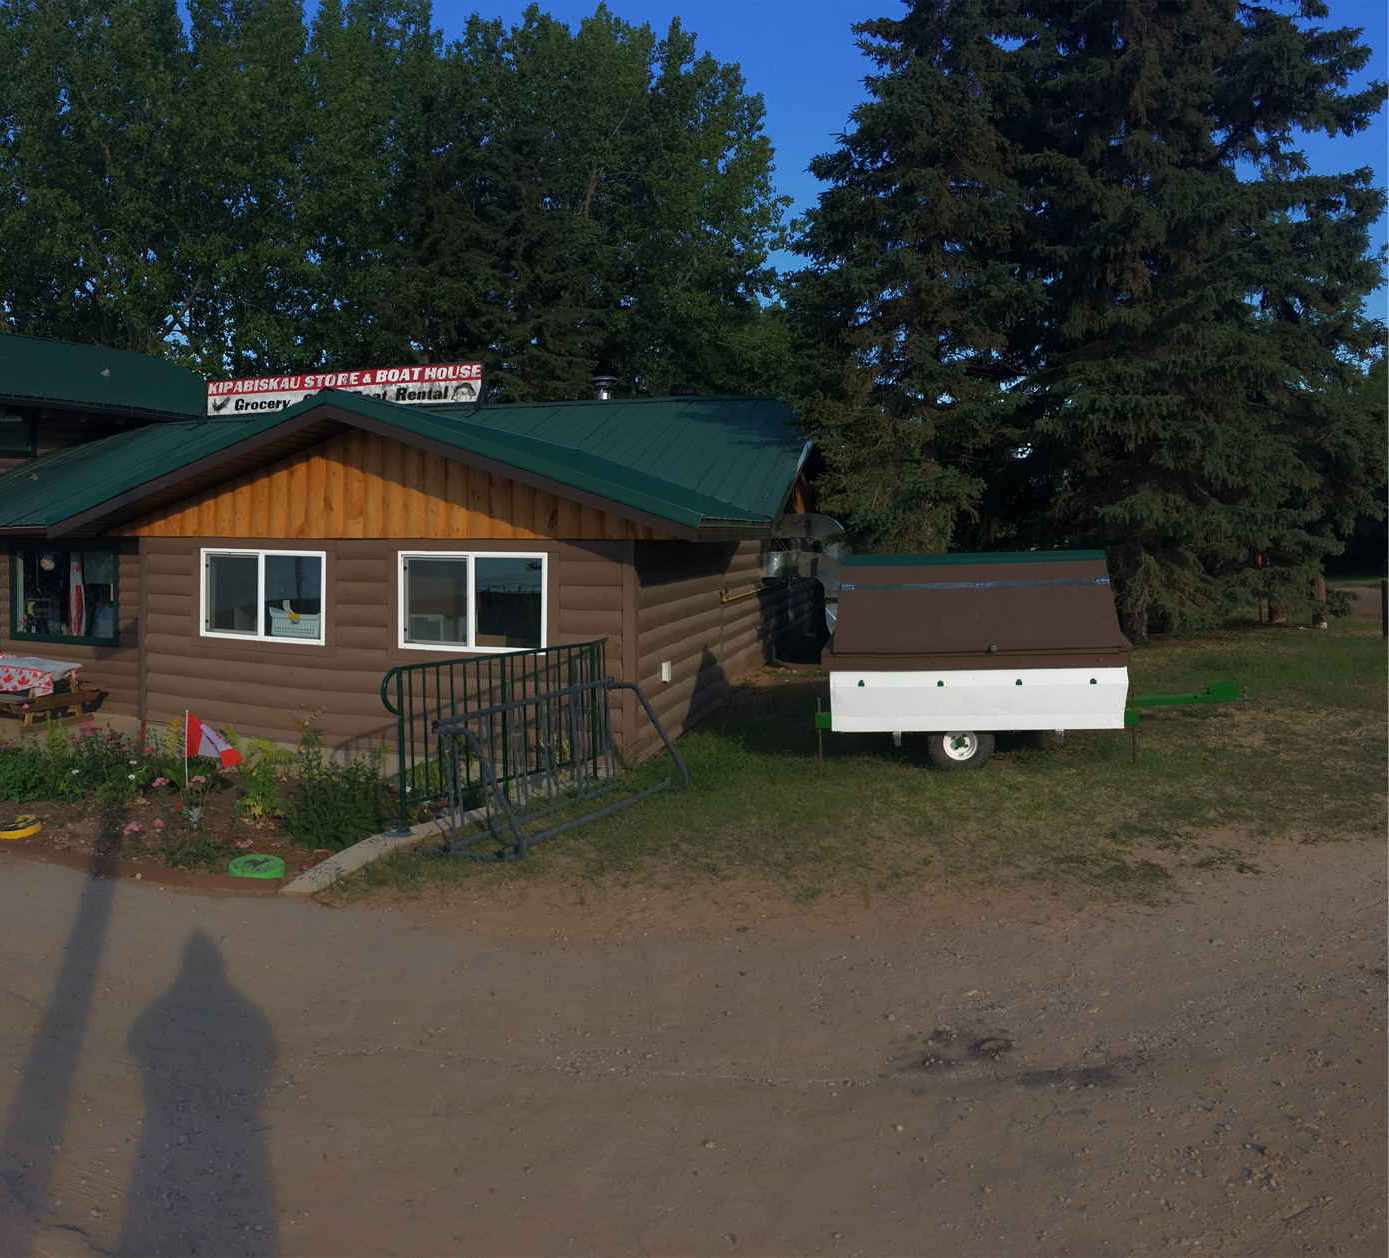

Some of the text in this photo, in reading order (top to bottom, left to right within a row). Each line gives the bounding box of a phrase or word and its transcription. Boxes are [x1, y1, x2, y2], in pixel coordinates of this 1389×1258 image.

[208, 364, 482, 394] KIPABISKAU STORE & BOAT HOUSE
[395, 386, 449, 401] Rental
